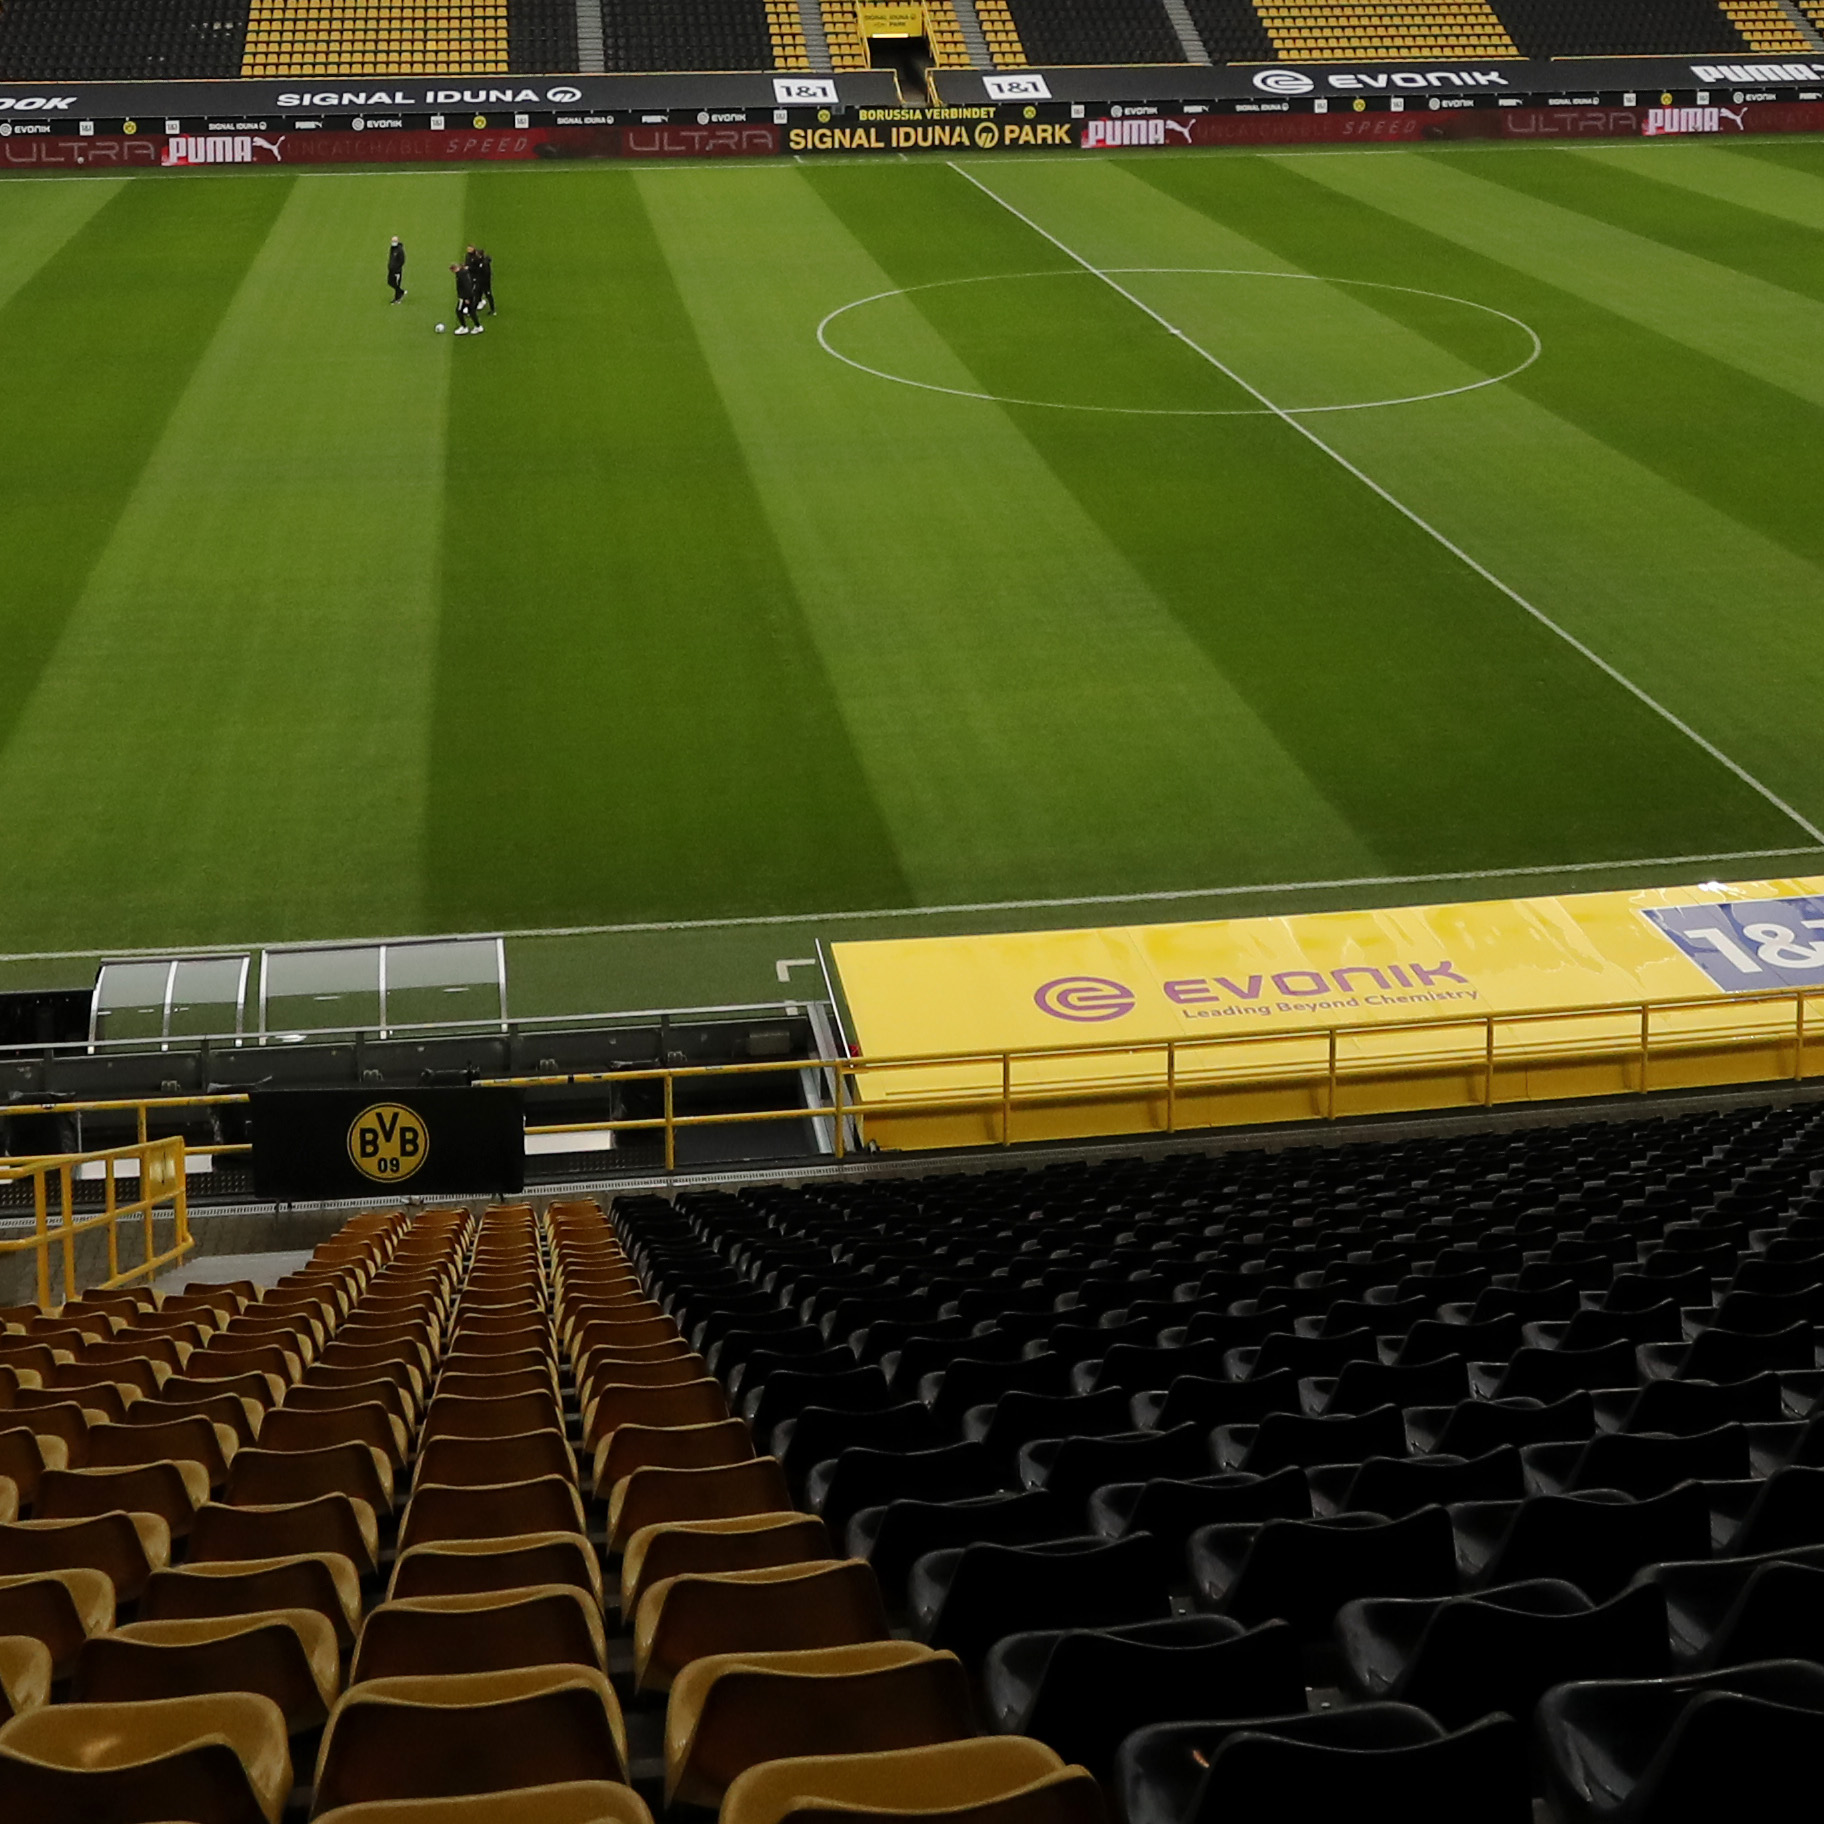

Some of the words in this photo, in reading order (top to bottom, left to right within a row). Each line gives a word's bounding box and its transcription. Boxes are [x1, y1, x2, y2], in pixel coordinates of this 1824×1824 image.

[1327, 70, 1509, 89] EVONIK
[1690, 64, 1820, 82] PUMA
[277, 91, 416, 107] SIGNAL
[425, 88, 540, 104] IDUNA
[779, 85, 831, 98] 1&1
[992, 82, 1043, 95] 1&1
[366, 119, 402, 128] EVONIK
[711, 113, 746, 122] EVONIK
[858, 108, 923, 122] BORUSSIA
[924, 106, 997, 120] VERBINDET
[1506, 112, 1638, 133] ULTRA
[1648, 108, 1720, 133] PUMA
[14, 125, 51, 134] EVONIK
[789, 128, 884, 149] SIGNAL
[891, 125, 970, 147] IDUNA
[1004, 122, 1072, 145] PARK
[1087, 119, 1165, 146] PUMA
[1342, 119, 1418, 135] SPEED
[169, 136, 253, 163] PUMA
[447, 138, 527, 153] SPEED
[628, 131, 774, 151] ULTRA
[4, 141, 154, 163] ULTRA
[1163, 960, 1470, 1005] EVONIK
[1182, 1004, 1271, 1019] Leading
[1276, 998, 1356, 1015] Beyond
[1358, 989, 1479, 1007] Chemistry
[359, 1112, 420, 1158] BVB
[377, 1158, 400, 1173] 09
